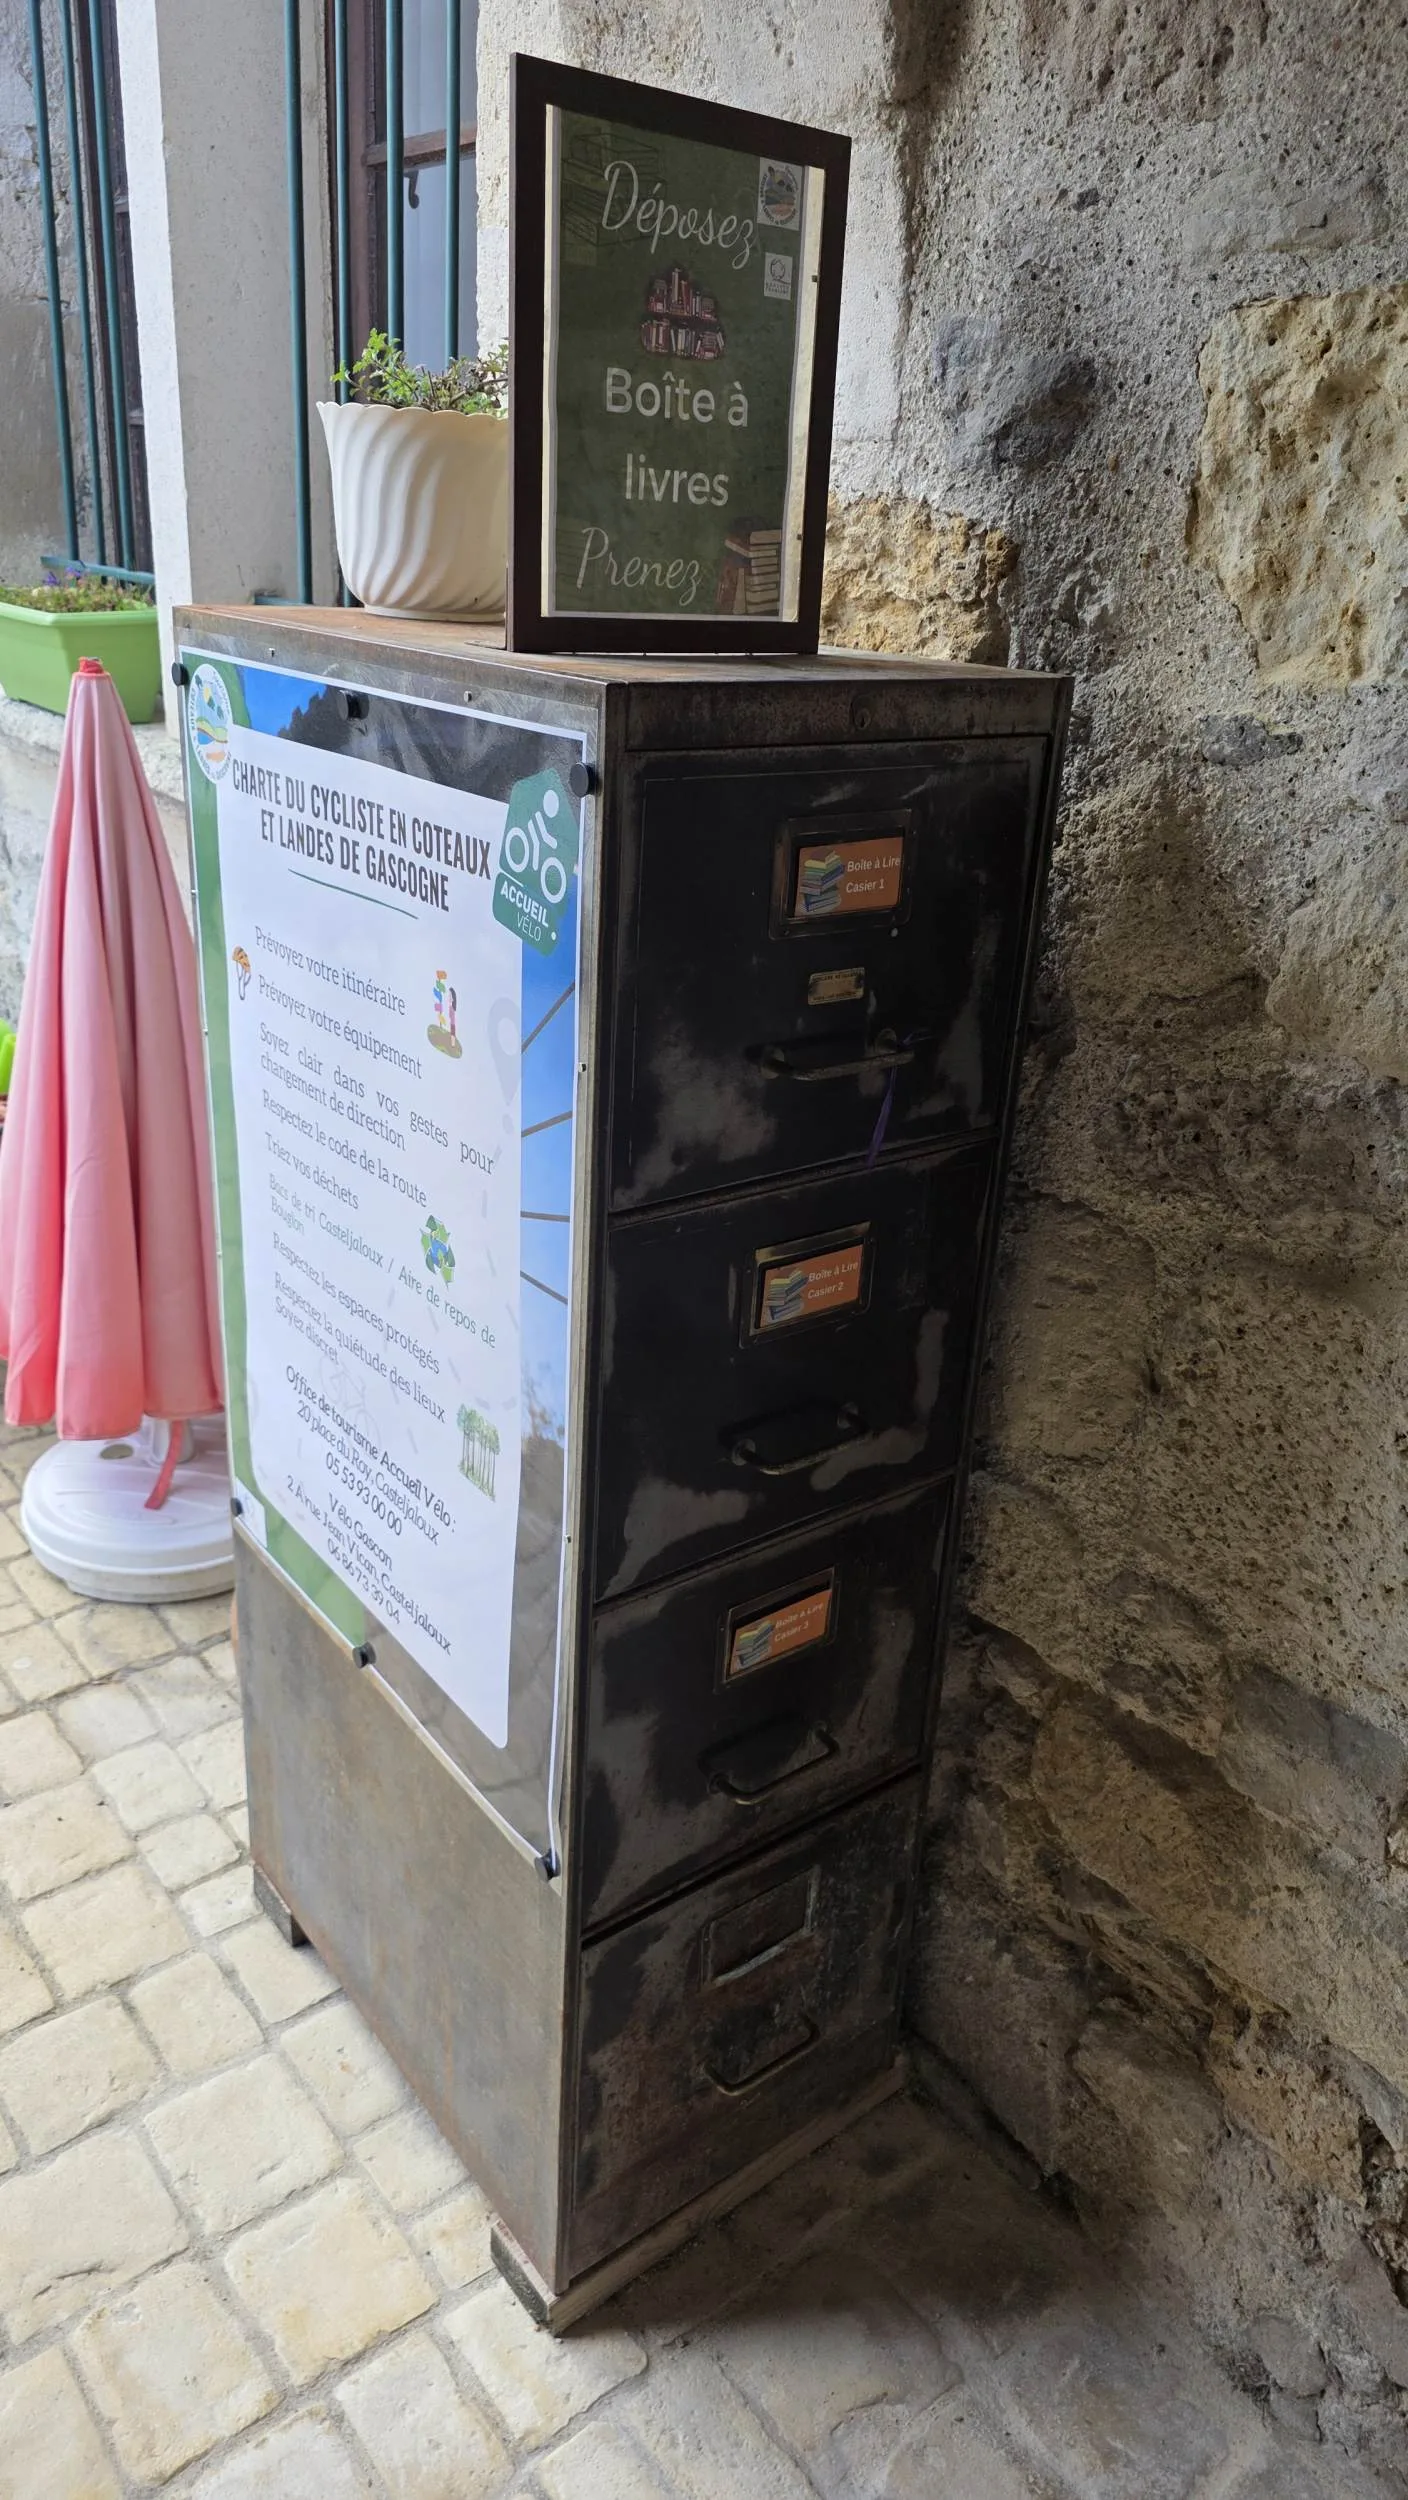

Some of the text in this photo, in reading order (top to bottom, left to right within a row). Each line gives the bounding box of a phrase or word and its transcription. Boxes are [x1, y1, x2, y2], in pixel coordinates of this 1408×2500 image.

[599, 160, 755, 269] Déposez
[606, 366, 749, 427] Boîte à
[625, 453, 730, 506] livres
[577, 526, 701, 606] Prenez
[232, 760, 491, 880] CHARTE DU CYCLISTE EN COTEAUX
[261, 809, 450, 912] ET LANDES DE GASCOGNE
[500, 880, 549, 928] ACCUEIL
[517, 911, 542, 942] VÉLO
[845, 878, 885, 894] Casier 1
[255, 926, 407, 1016] Prévoyez votre itinéraire
[259, 974, 422, 1080] Prévoyez votre équipement
[260, 1022, 495, 1176] Soyez clair dans vos gestes pour
[260, 1052, 406, 1152] changement de direction
[263, 1088, 428, 1208] Respectez le code de la route
[265, 1131, 359, 1210] Triez vos déchets
[273, 1231, 440, 1375] Respectez les espaces protégés
[275, 1296, 339, 1366] Soyez discret
[319, 1212, 384, 1269] Casteljaloux
[398, 1265, 422, 1295] Aire
[426, 1287, 441, 1308] de
[444, 1301, 477, 1335] repos
[481, 1326, 496, 1350] de
[323, 1311, 333, 1336] la
[335, 1328, 388, 1378] quiétude
[389, 1365, 411, 1396] des
[413, 1380, 446, 1424] lieux
[286, 1365, 317, 1404] Office
[318, 1393, 331, 1417] de
[331, 1405, 379, 1460] tourisme
[380, 1450, 422, 1501] Accueil
[424, 1485, 451, 1527] Vélo
[297, 1399, 311, 1423] 20
[310, 1416, 337, 1447] place
[337, 1436, 351, 1461] du
[375, 1471, 440, 1546] Casteljaloux
[326, 1451, 403, 1536] 05 53 93 00 00
[287, 1474, 294, 1492] 2
[381, 1572, 452, 1656] Casteljaloux
[328, 1491, 393, 1572] Vélo Gascon
